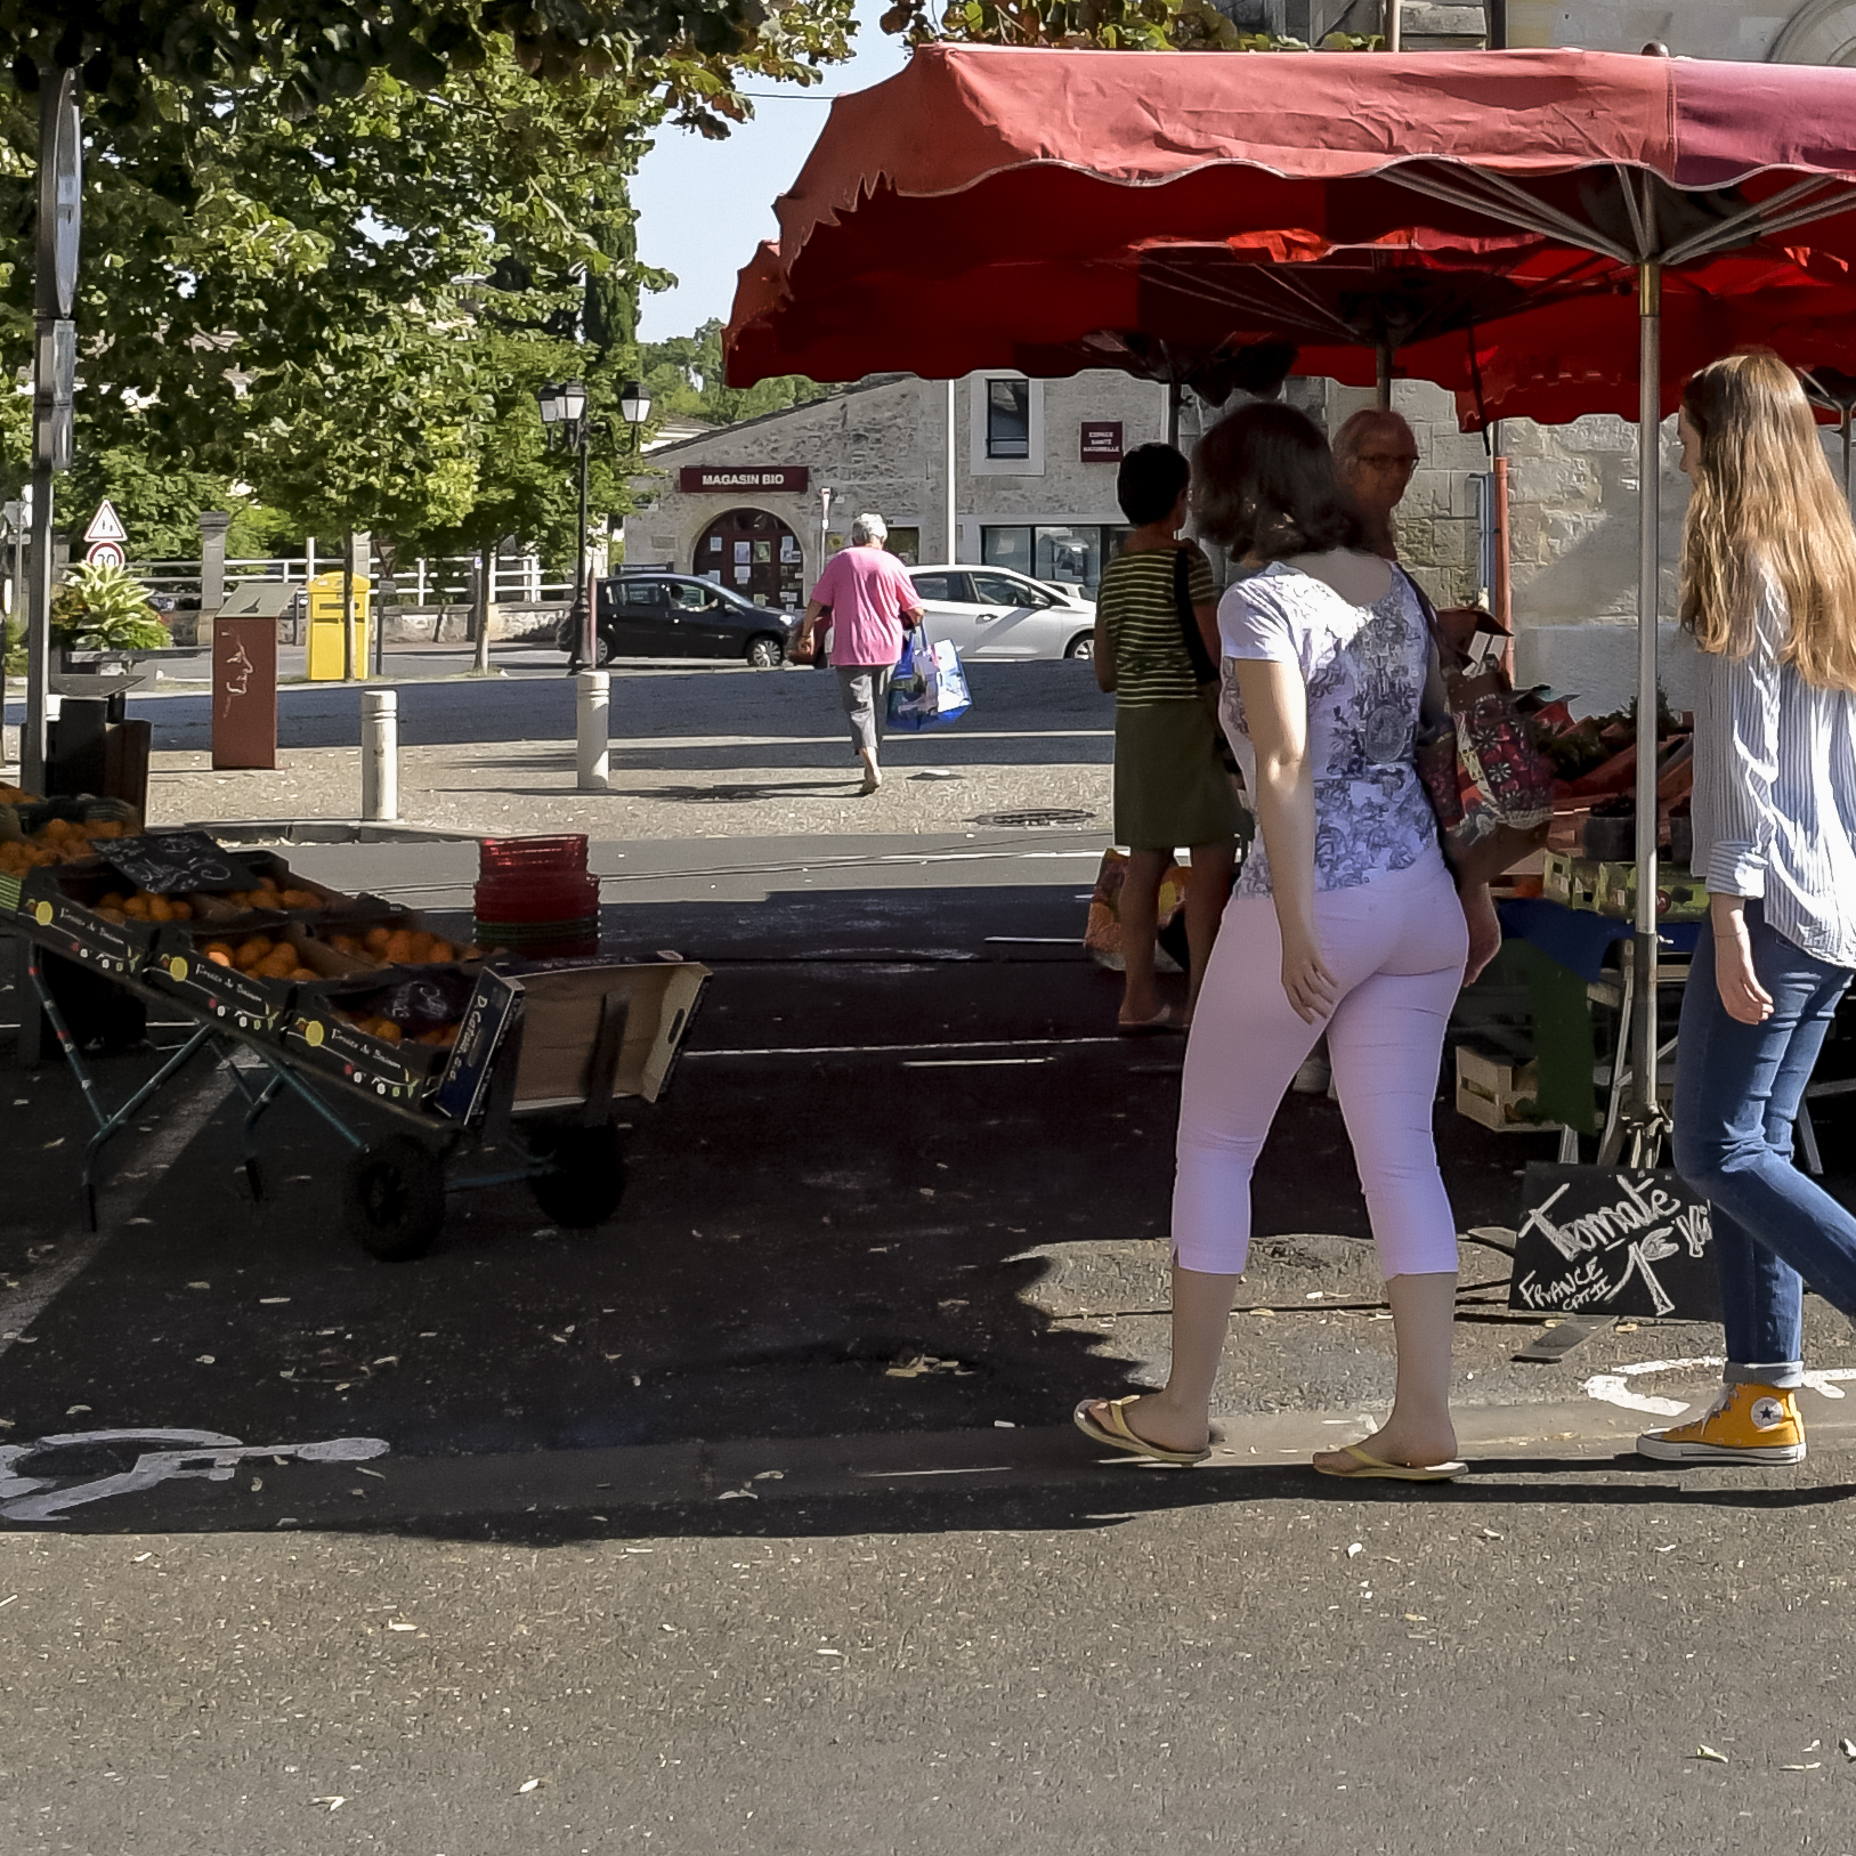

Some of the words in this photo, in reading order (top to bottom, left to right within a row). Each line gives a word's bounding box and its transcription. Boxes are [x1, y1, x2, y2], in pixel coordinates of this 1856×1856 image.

[702, 474, 759, 485] MAGASIN
[762, 474, 785, 485] BIO
[1518, 1174, 1682, 1263] Tomate
[1518, 1255, 1604, 1310] FRANCE
